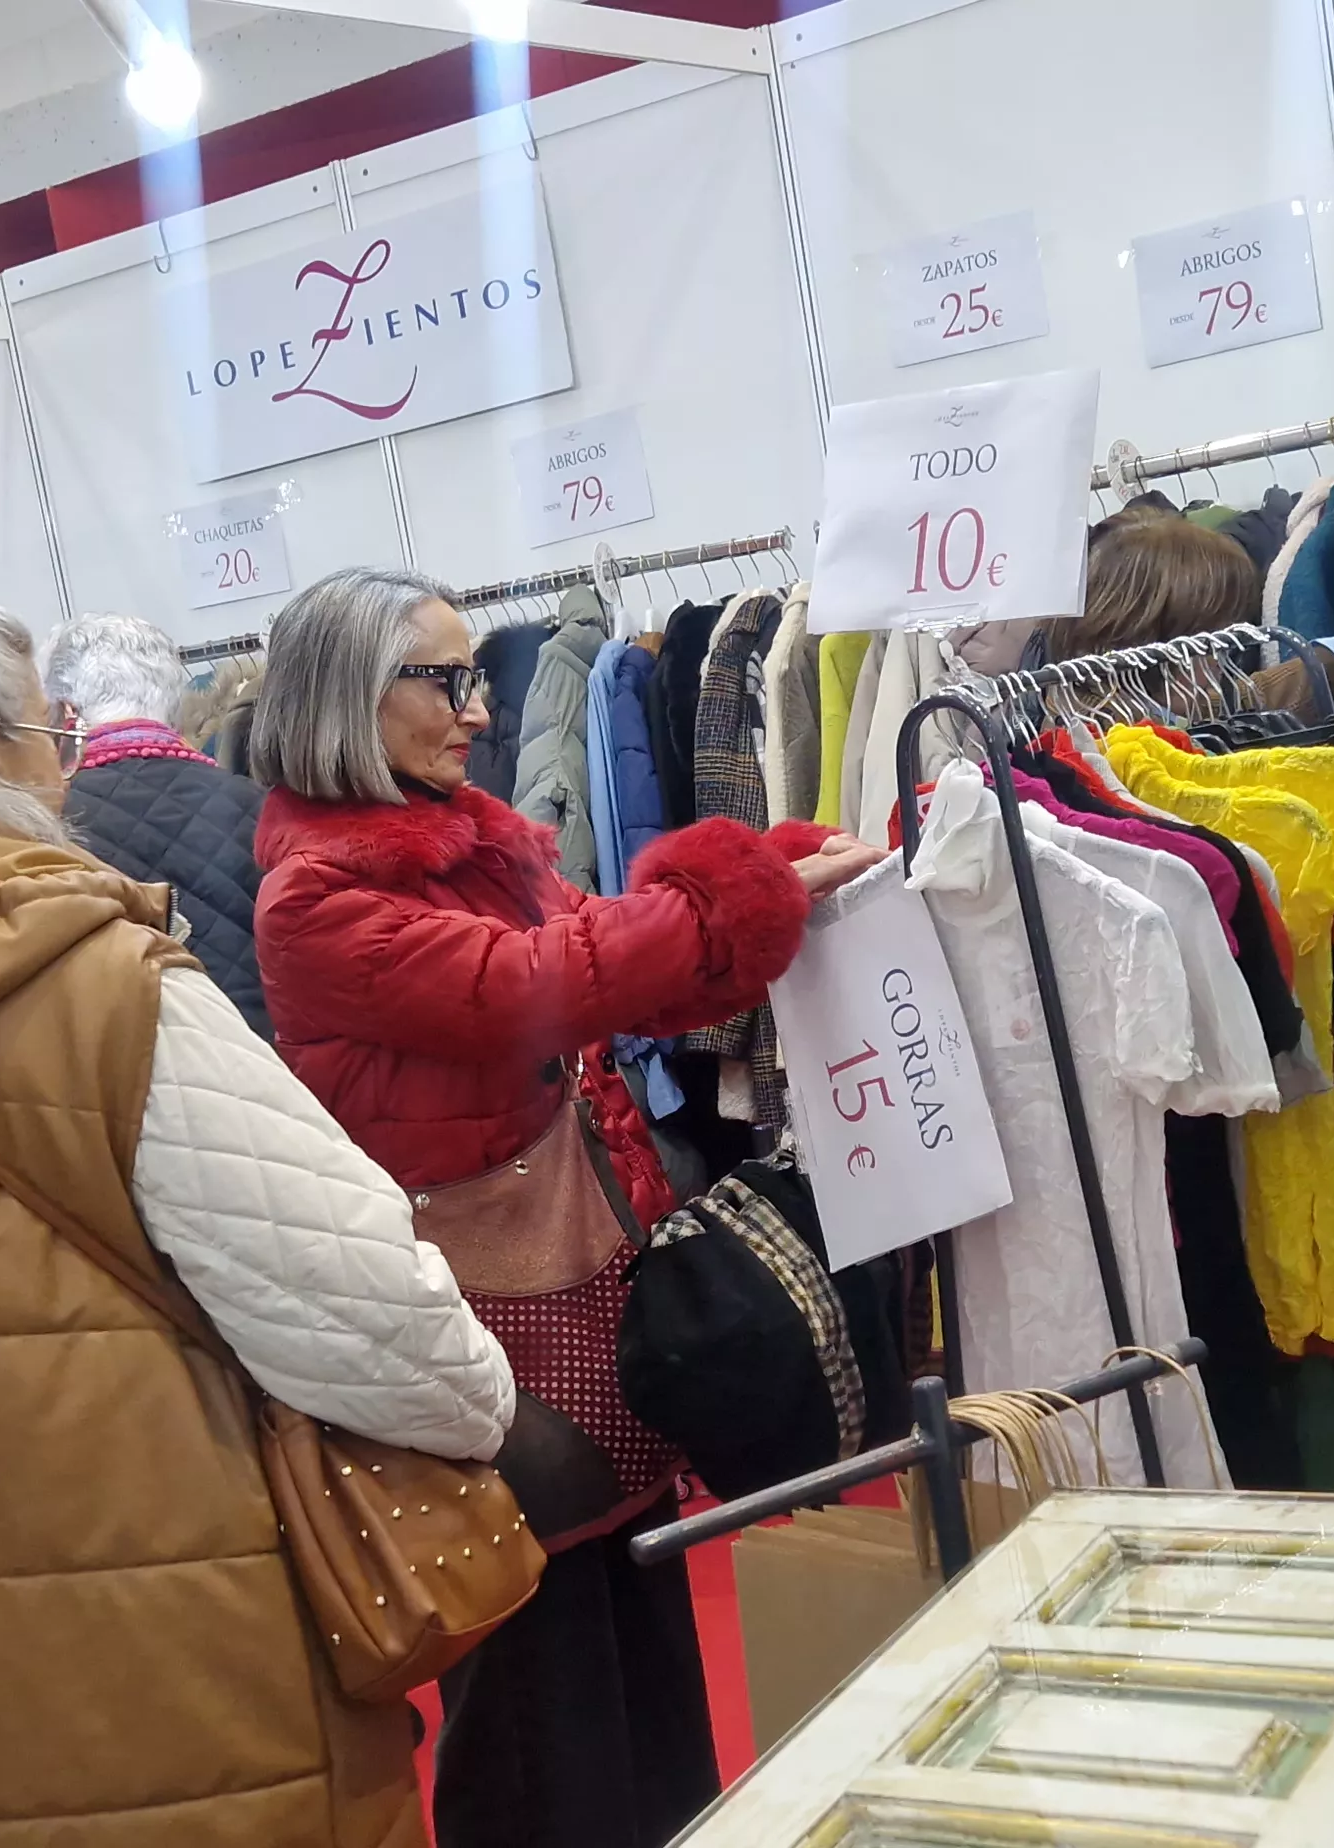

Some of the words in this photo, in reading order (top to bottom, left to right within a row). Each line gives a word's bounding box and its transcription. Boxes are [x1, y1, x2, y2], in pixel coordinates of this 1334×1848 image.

[921, 249, 998, 283] ZAPATOS
[1180, 240, 1262, 277] ABRIGOS
[940, 282, 1004, 339] 25€
[1198, 281, 1268, 336] 79€
[548, 443, 607, 472] ABRIGOS
[909, 443, 997, 481] TODO
[562, 476, 616, 521] 79€
[194, 517, 264, 544] CHAQUETAS
[906, 507, 1008, 595] 10€
[882, 968, 954, 1150] GORRAS
[825, 1038, 896, 1122] 15
[847, 1143, 876, 1178] €
